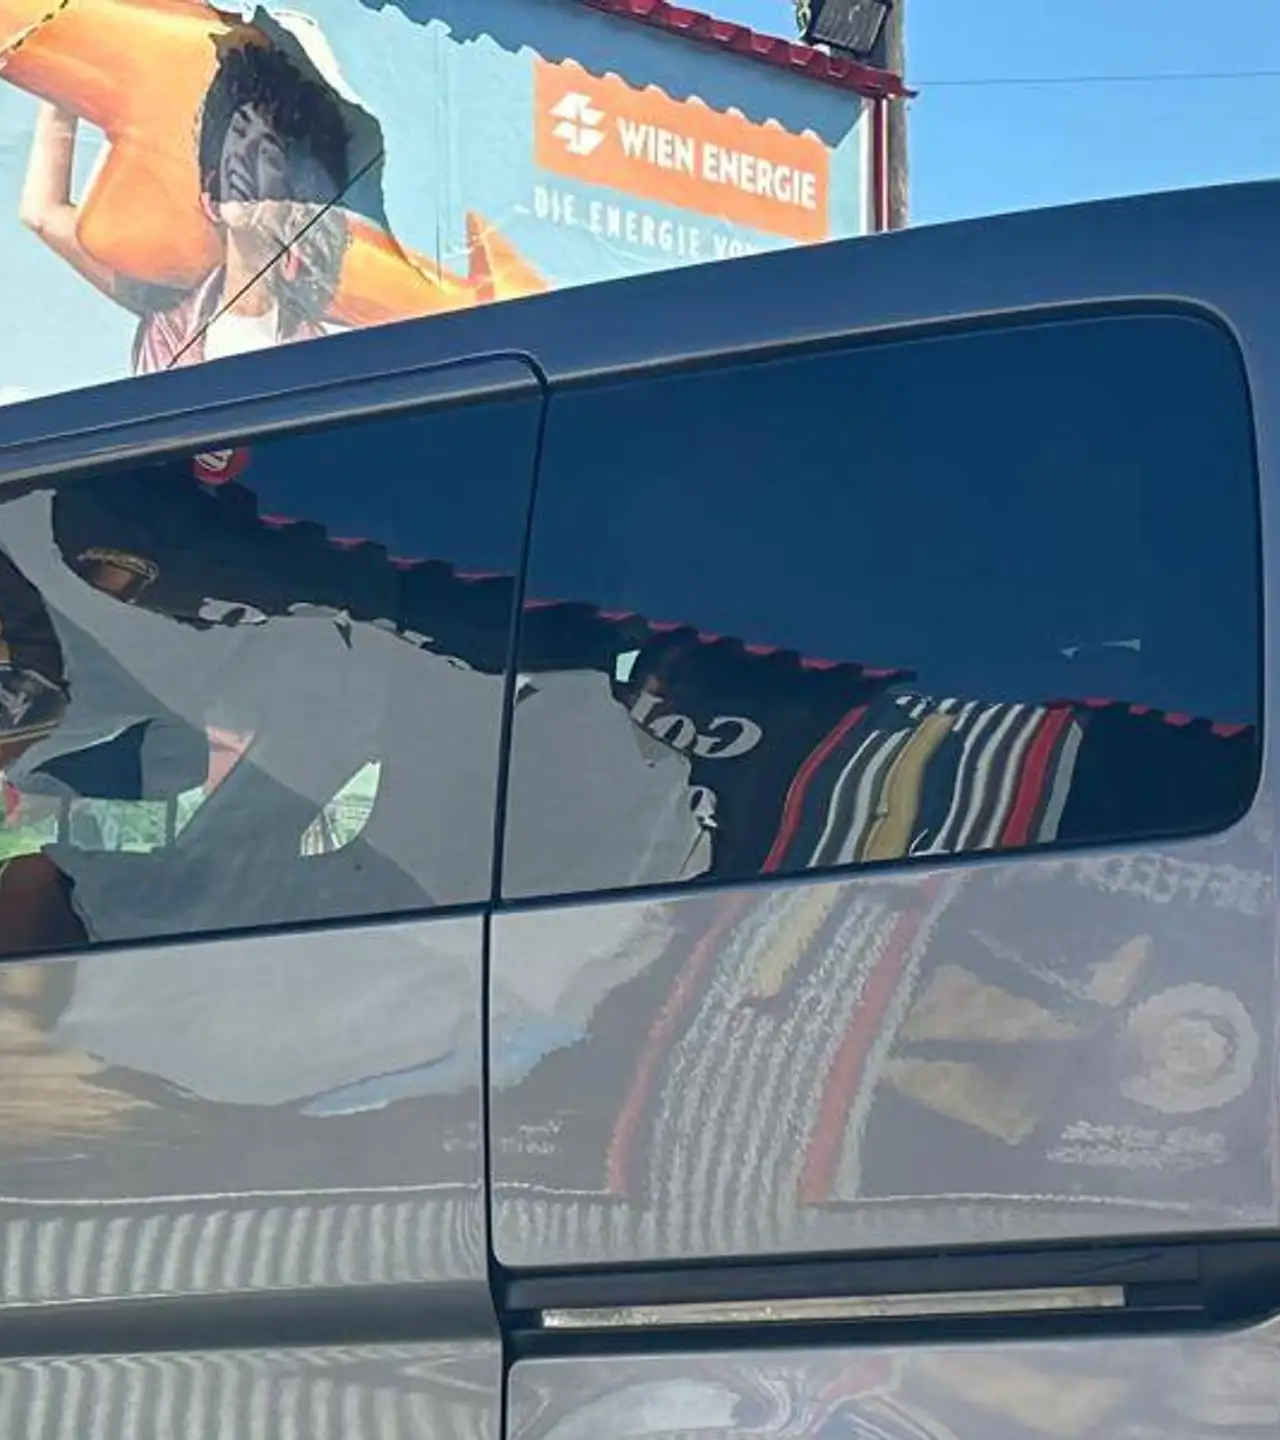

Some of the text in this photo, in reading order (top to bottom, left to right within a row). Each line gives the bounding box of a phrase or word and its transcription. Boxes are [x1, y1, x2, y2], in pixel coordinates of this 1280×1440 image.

[617, 116, 817, 210] WIEN ENERGIE
[534, 185, 576, 224] DIE
[589, 200, 701, 261] ENERGIE
